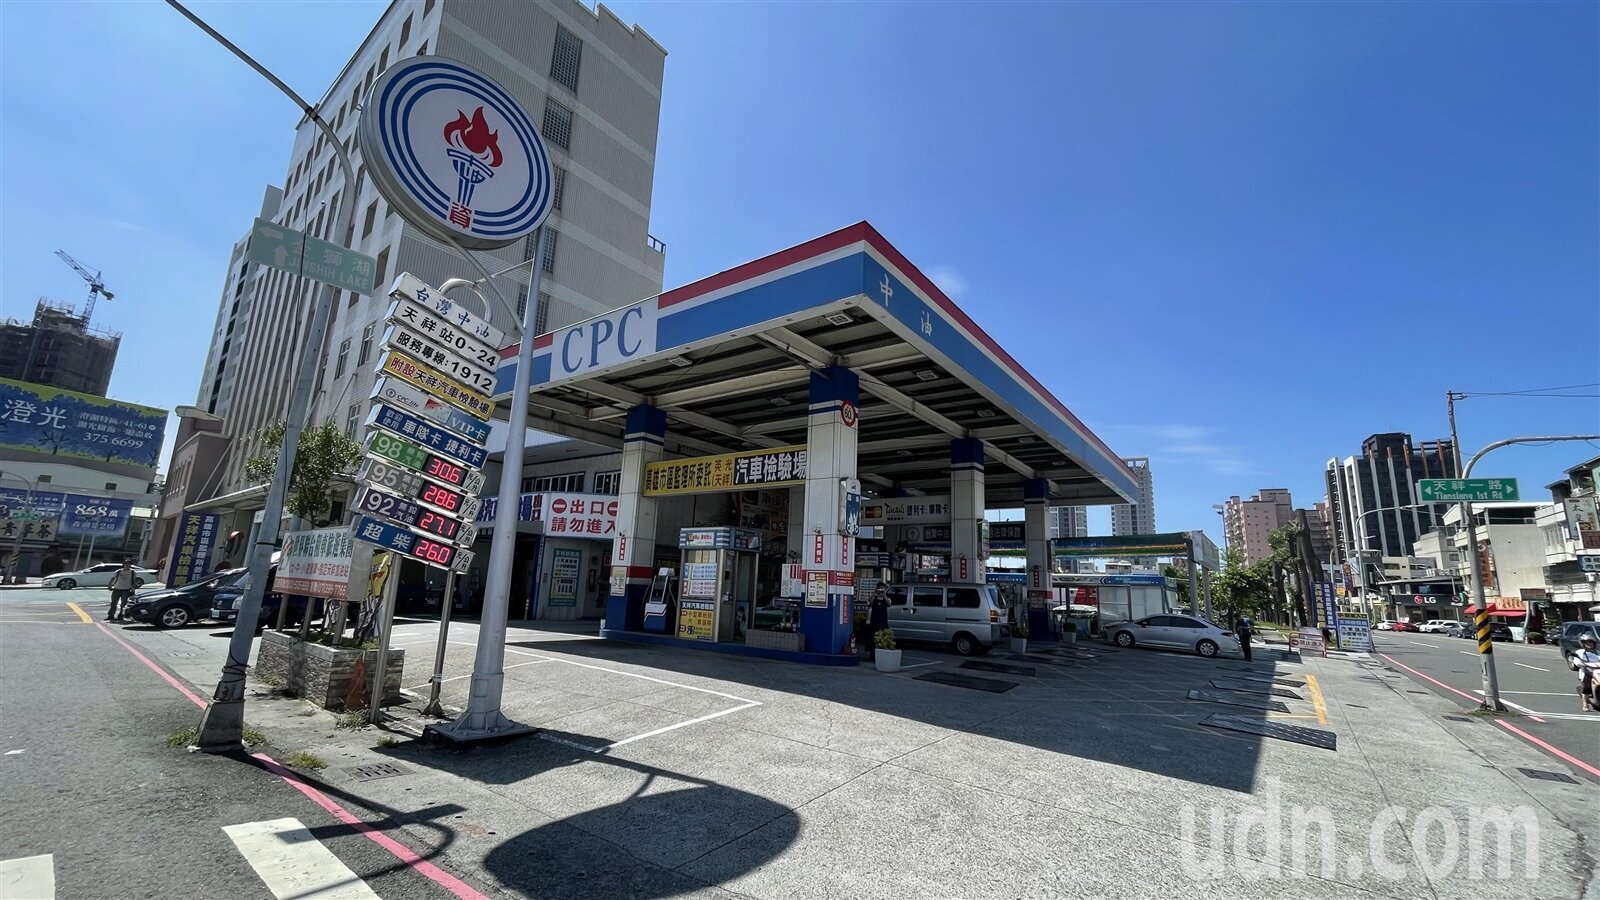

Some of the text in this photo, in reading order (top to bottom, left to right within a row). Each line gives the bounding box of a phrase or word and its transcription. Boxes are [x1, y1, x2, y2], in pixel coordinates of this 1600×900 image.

[449, 202, 473, 229] 資
[340, 272, 368, 289] LAKE
[416, 287, 490, 338] 台灣中油
[880, 273, 932, 337] 中油
[561, 306, 643, 374] CPC
[390, 357, 490, 414] 附設天祥汽車檢驗場
[1, 398, 67, 430] 澄光
[83, 432, 144, 449] 375 6699
[375, 435, 403, 462] 98
[402, 419, 482, 464] 車隊卡 捷利卡
[371, 464, 400, 487] 95
[735, 451, 807, 484] 汽車檢驗場
[1433, 480, 1503, 491] 天祥一路
[1492, 491, 1504, 500] Rd
[367, 492, 395, 516] 92
[570, 499, 604, 515] 出口
[362, 522, 411, 550] 超柴
[551, 516, 616, 534] 請勿進入
